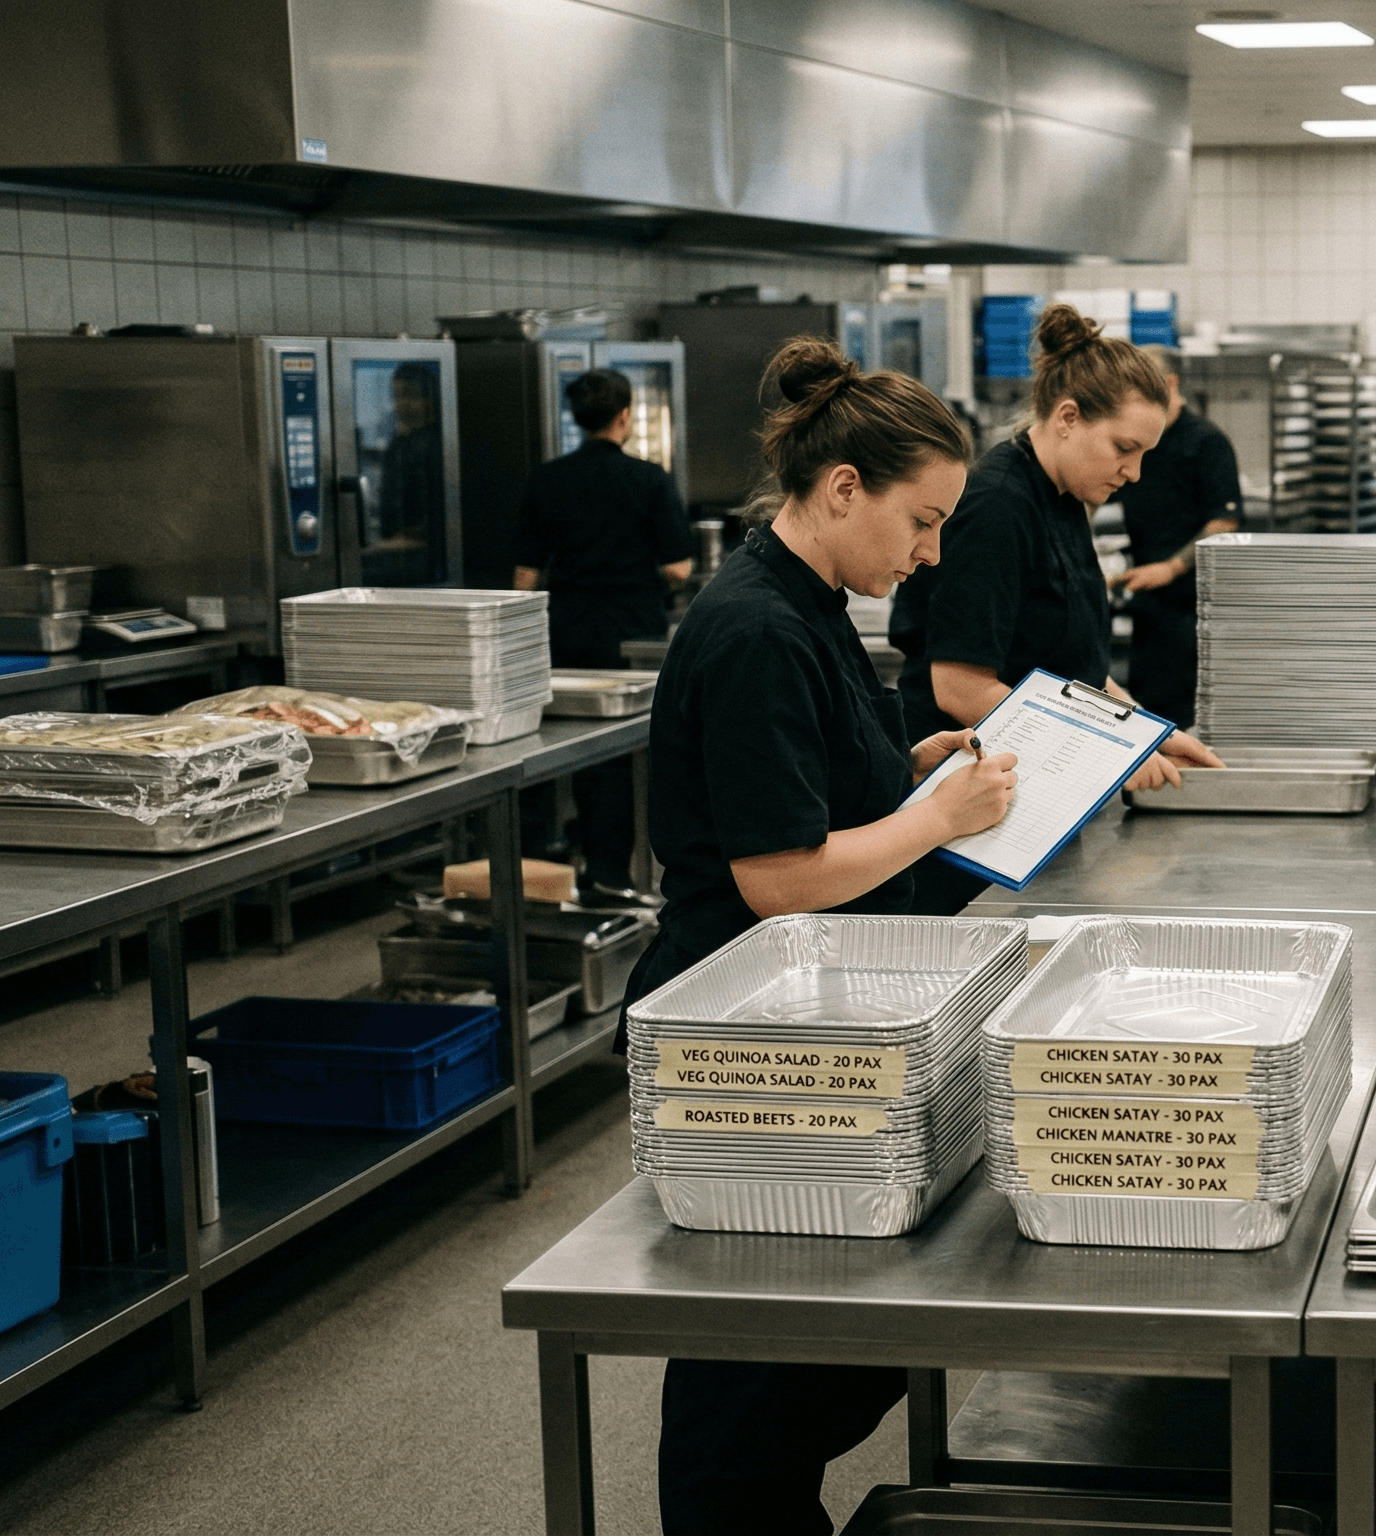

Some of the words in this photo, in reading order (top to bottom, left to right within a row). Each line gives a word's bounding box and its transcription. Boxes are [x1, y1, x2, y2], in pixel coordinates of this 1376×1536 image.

[681, 1048, 710, 1062] VEG
[713, 1050, 772, 1066] QUINOA
[774, 1052, 821, 1067] SALAD
[832, 1055, 851, 1068] 20
[854, 1056, 883, 1069] PAX
[1046, 1048, 1109, 1062] CHICKEN
[1112, 1050, 1159, 1063] SATAY
[1172, 1051, 1191, 1064] 30
[1194, 1051, 1223, 1065] PAX
[676, 1069, 706, 1083] VEG
[708, 1070, 767, 1086] QUINOA
[769, 1073, 816, 1088] SALAD
[828, 1075, 846, 1089] 20
[848, 1076, 877, 1090] PAX
[1040, 1070, 1102, 1085] CHICKEN
[1105, 1072, 1153, 1086] SATAY
[1167, 1073, 1186, 1087] 30
[1189, 1074, 1218, 1087] PAX
[685, 1109, 750, 1124] ROASTED
[753, 1112, 796, 1126] BEETS
[808, 1114, 826, 1127] 20
[829, 1115, 858, 1128] PAX
[1048, 1105, 1110, 1120] CHICKEN
[1113, 1107, 1160, 1121] SATAY
[1173, 1109, 1192, 1123] 30
[1195, 1109, 1224, 1123] PAX
[1036, 1127, 1098, 1141] CHICKEN
[1101, 1129, 1173, 1144] MANATRE
[1186, 1131, 1205, 1145] 30
[1208, 1132, 1237, 1146] PAX
[1050, 1151, 1112, 1166] CHICKEN
[1115, 1153, 1163, 1167] SATAY
[1175, 1155, 1194, 1169] 30
[1197, 1156, 1226, 1170] PAX
[1051, 1173, 1113, 1188] CHICKEN
[1117, 1175, 1164, 1189] SATAY
[1176, 1177, 1195, 1191] 30
[1198, 1178, 1228, 1192] PAX
